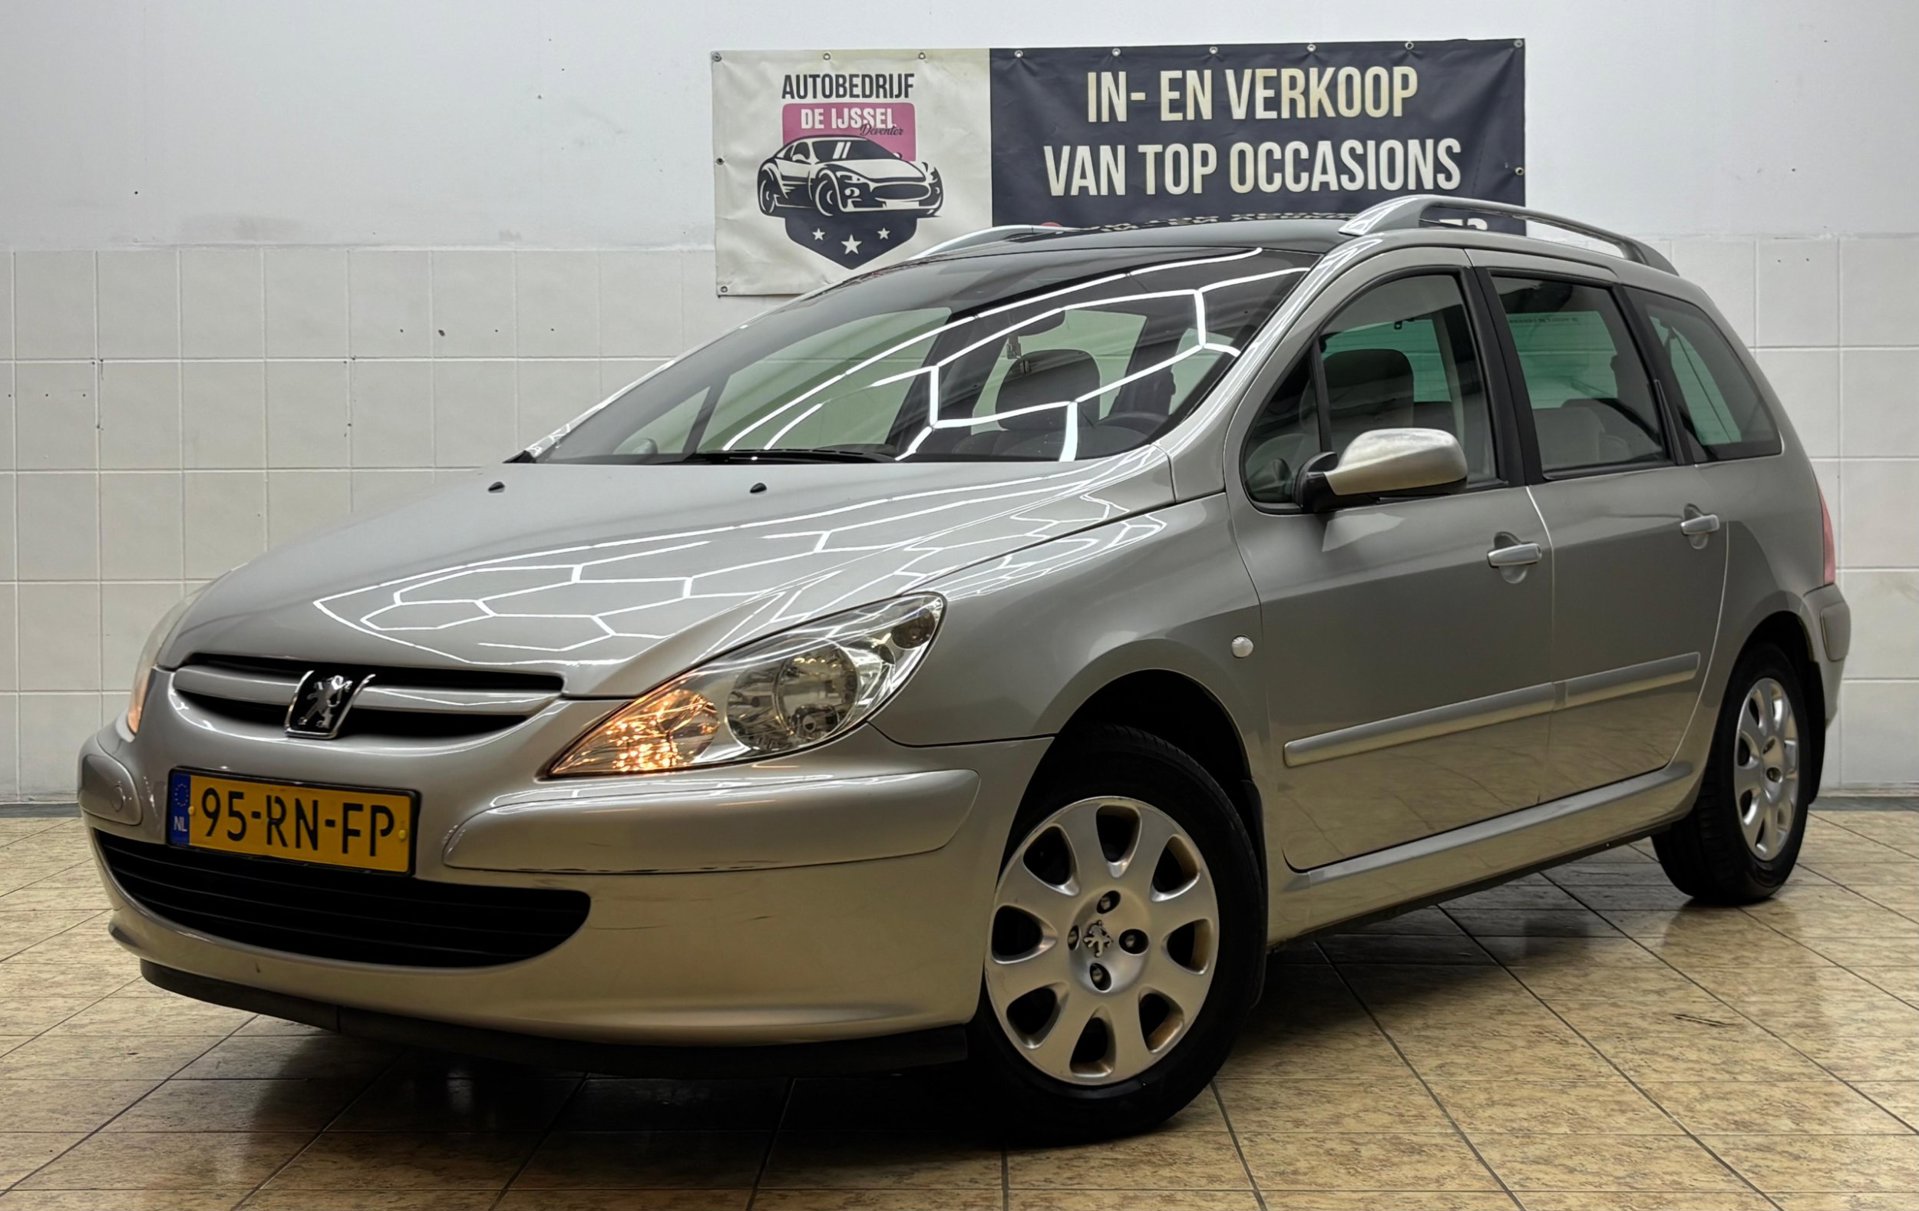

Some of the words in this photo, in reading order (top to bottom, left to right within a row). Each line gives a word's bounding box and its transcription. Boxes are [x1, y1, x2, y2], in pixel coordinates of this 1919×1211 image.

[781, 73, 914, 99] AUTOBEDRIJF
[1087, 71, 1146, 123] IN-
[1160, 69, 1212, 122] EN
[1225, 66, 1418, 120] VERKOOP
[801, 108, 824, 129] DE
[832, 107, 895, 129] IJSSEL
[1043, 144, 1126, 196] VAN
[1138, 142, 1217, 195] TOP
[1230, 137, 1462, 194] OCCASIONS
[173, 815, 188, 832] NL
[201, 787, 395, 857] 95-RN-FP
